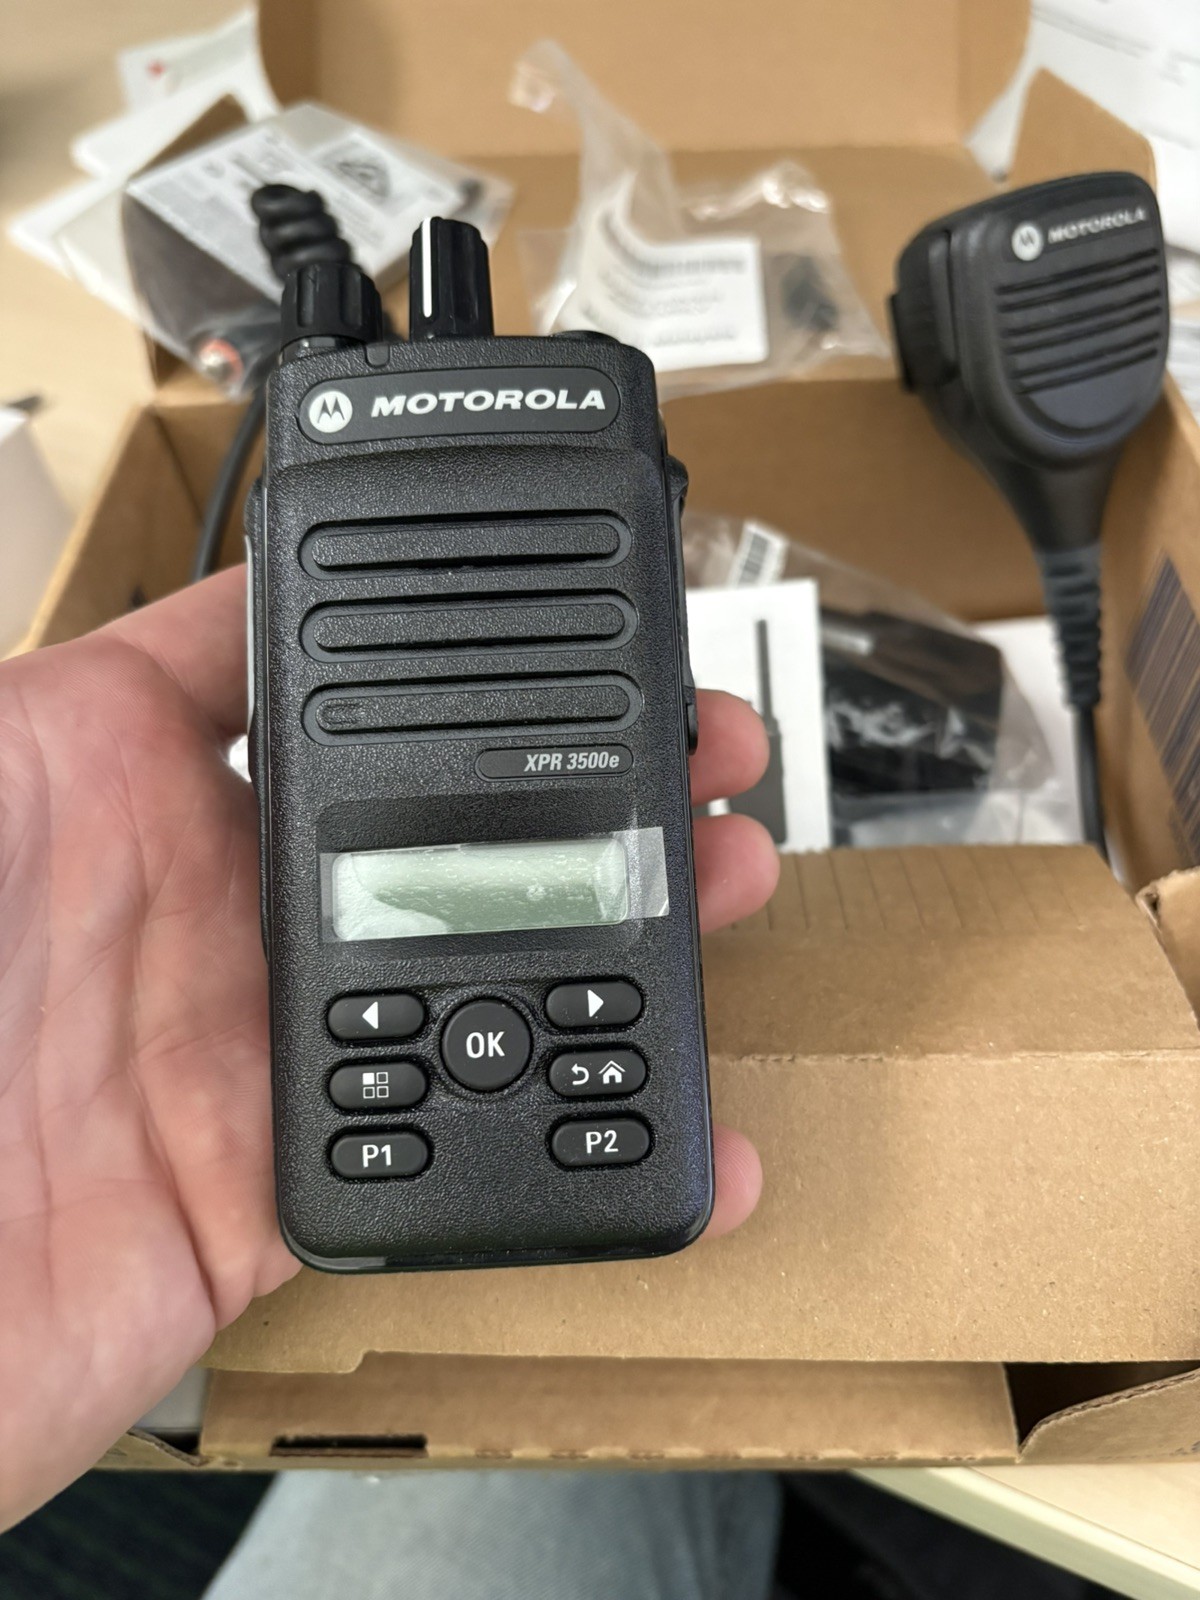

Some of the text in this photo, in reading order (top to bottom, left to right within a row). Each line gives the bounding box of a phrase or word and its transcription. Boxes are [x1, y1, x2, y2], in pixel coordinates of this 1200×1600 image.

[1047, 207, 1146, 244] MOTOROLA
[370, 388, 606, 418] MOTOROLA
[523, 751, 620, 773] XPR 3500e
[465, 1031, 506, 1059] OK
[585, 1129, 619, 1154] P2
[361, 1143, 392, 1169] P1
